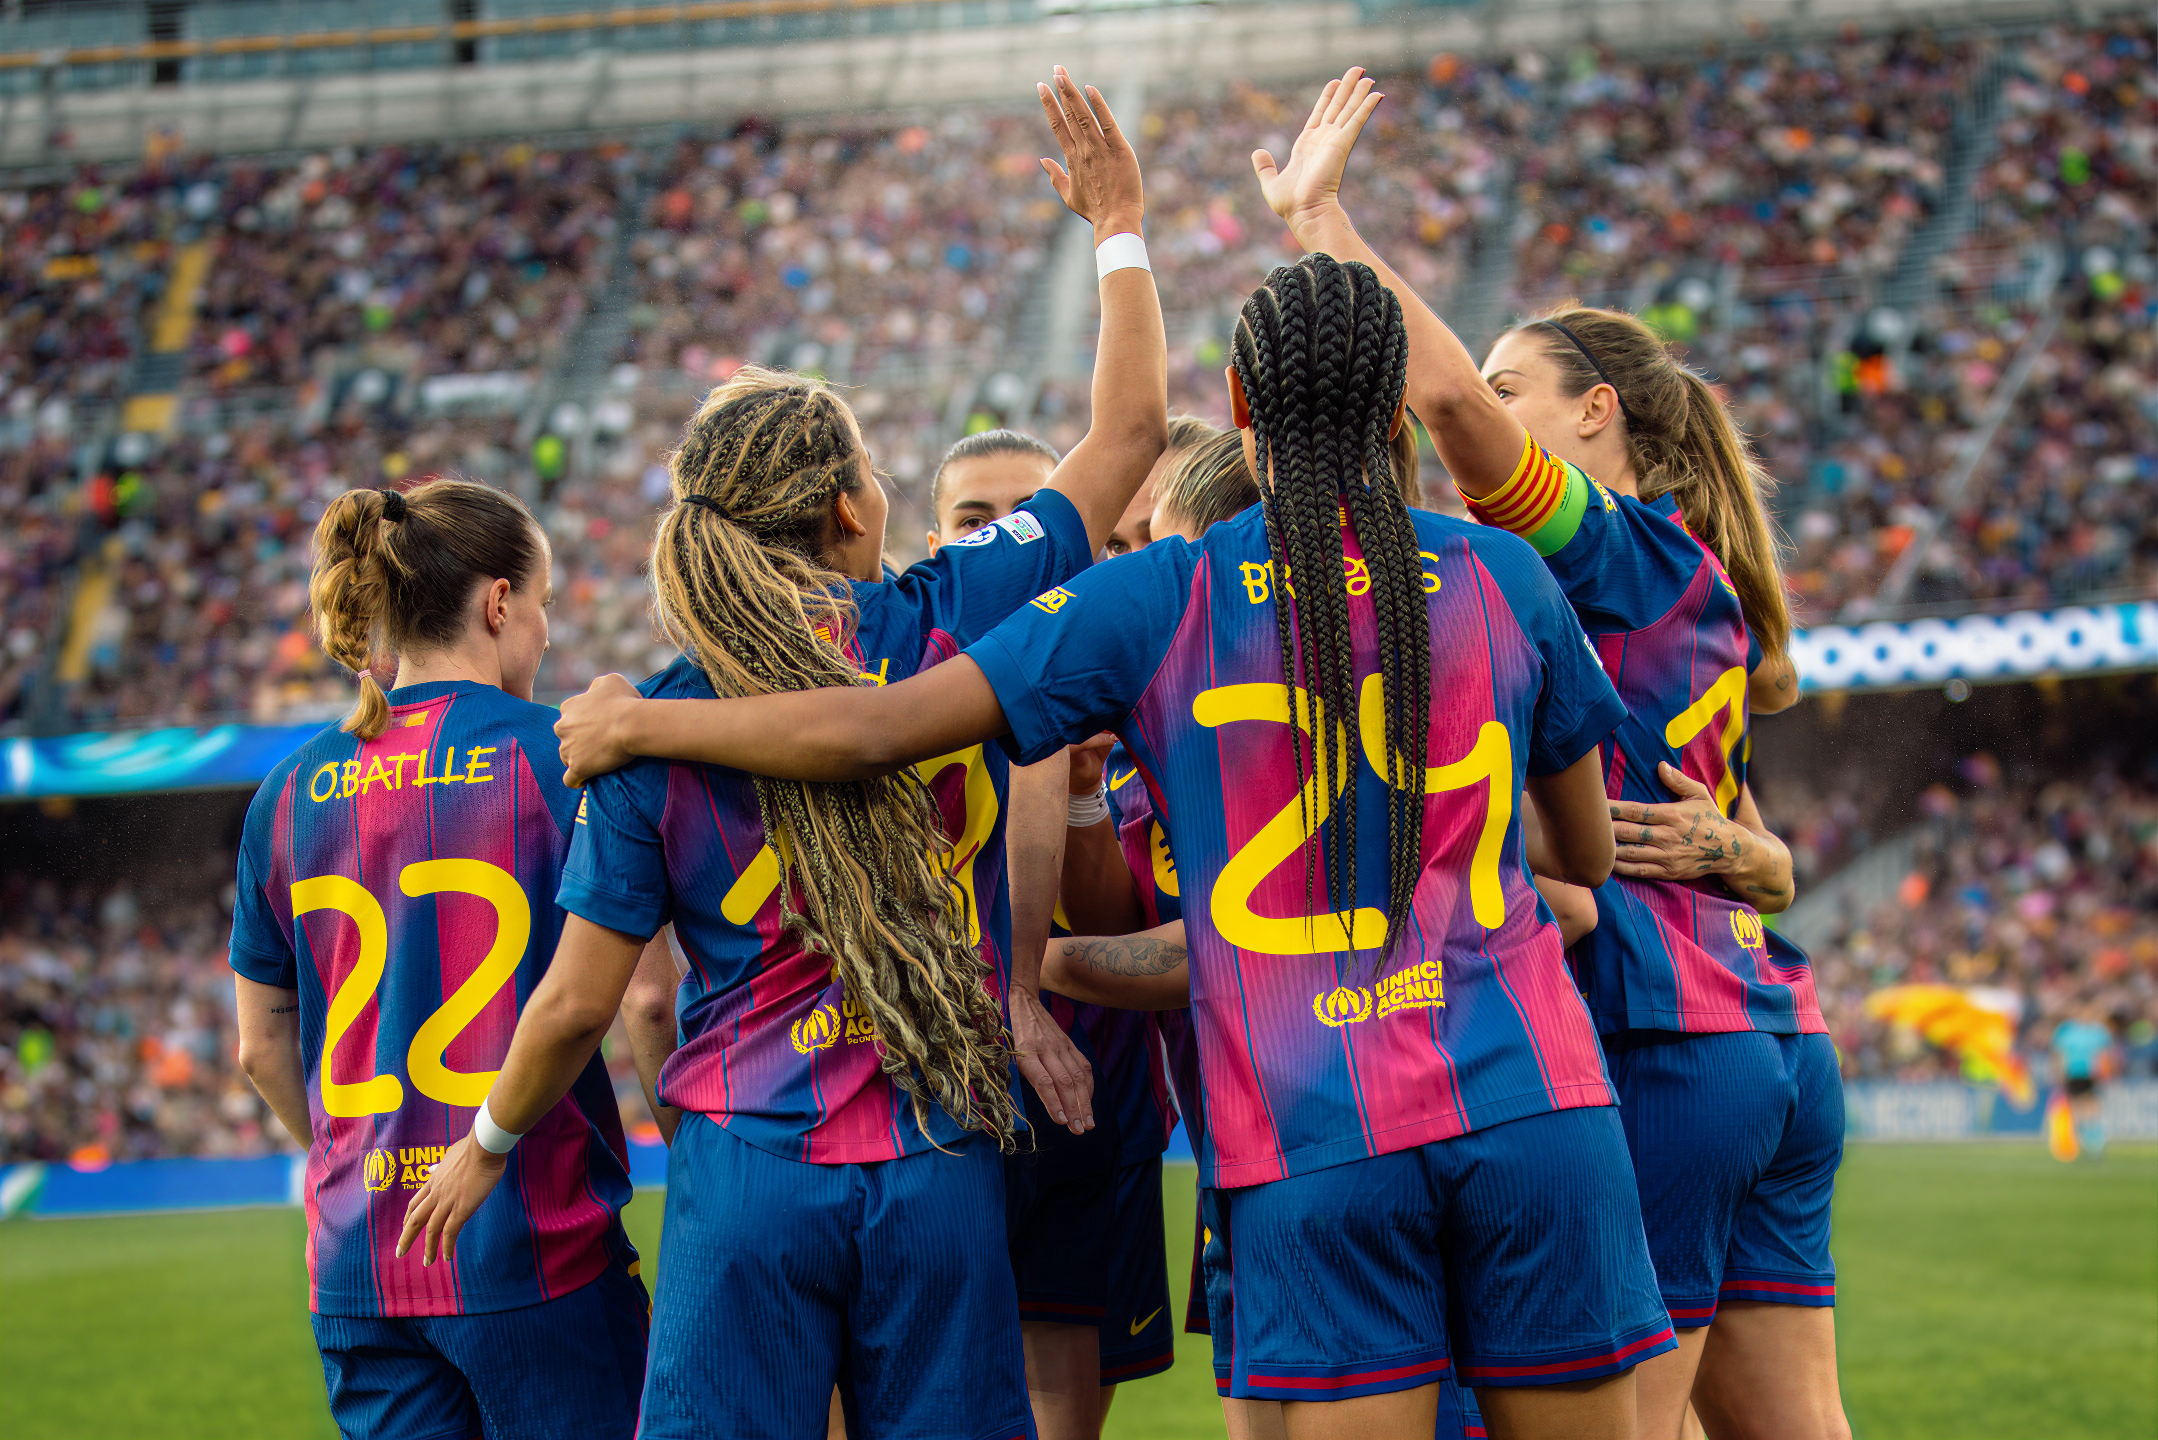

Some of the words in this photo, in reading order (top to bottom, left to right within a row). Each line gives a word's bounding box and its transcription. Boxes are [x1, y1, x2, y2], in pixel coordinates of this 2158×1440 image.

[310, 745, 497, 803] O.BATLLE
[1193, 673, 1513, 956] 24
[290, 857, 531, 1118] 22
[399, 1145, 452, 1166] UNH
